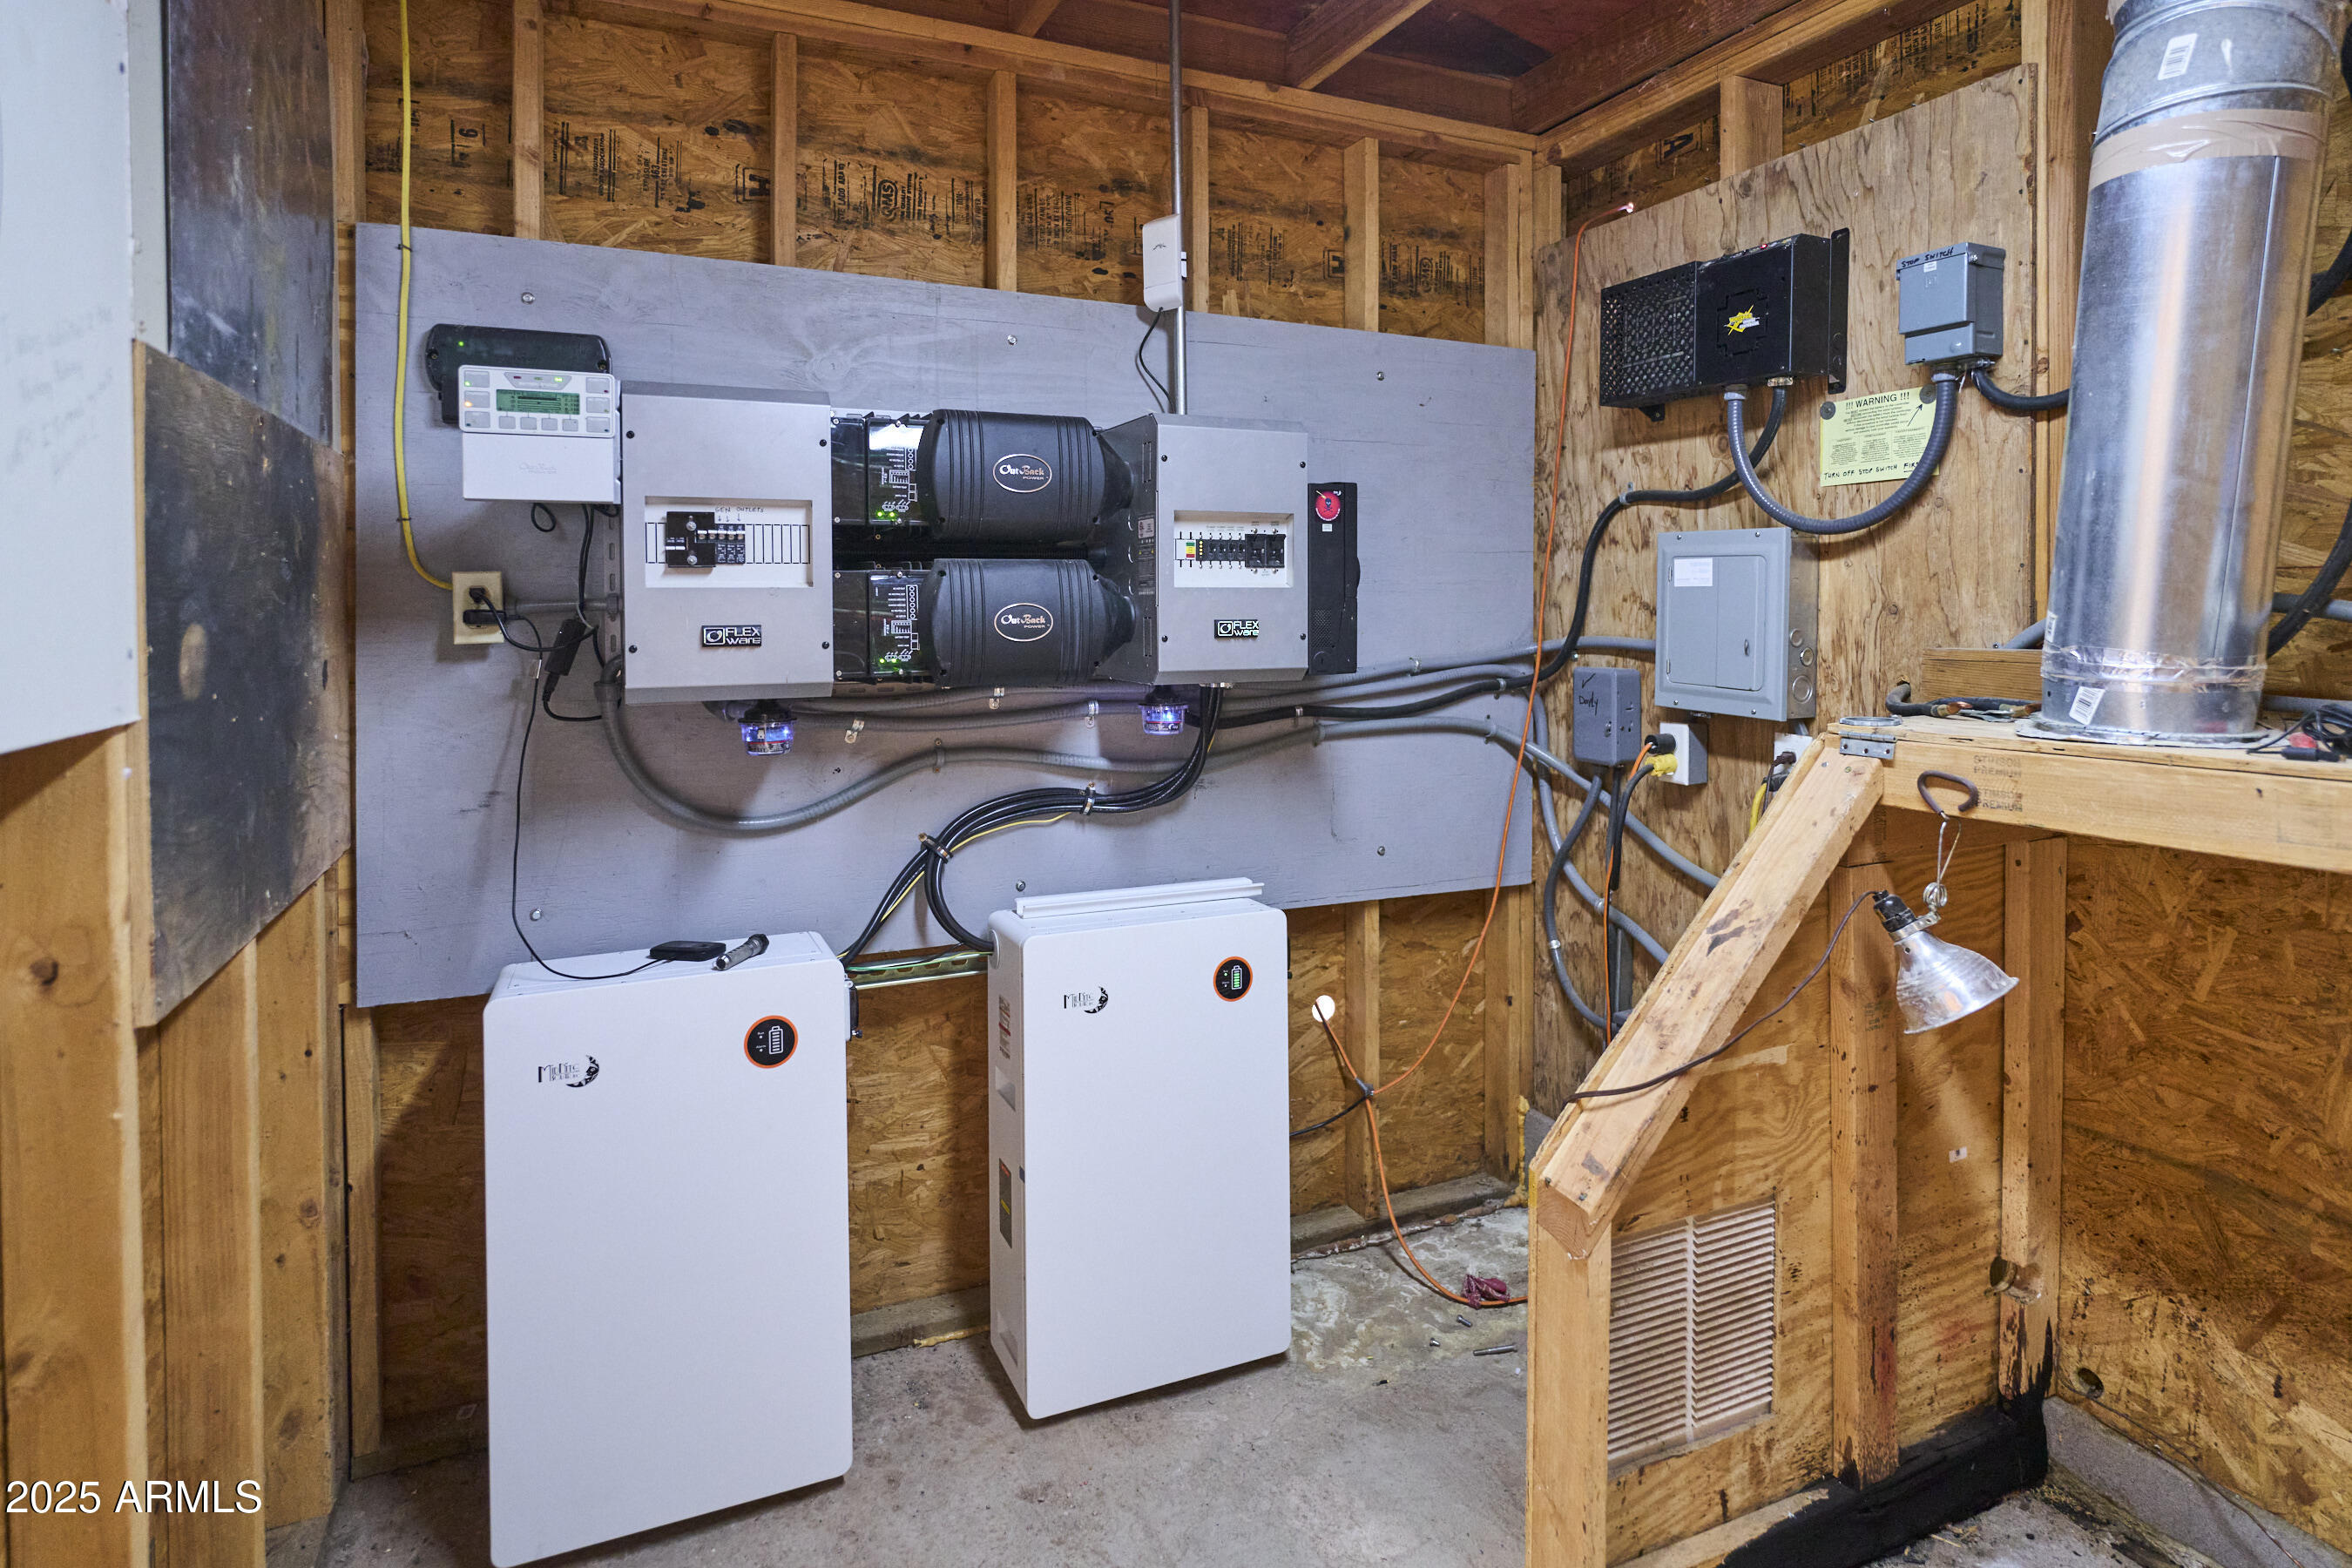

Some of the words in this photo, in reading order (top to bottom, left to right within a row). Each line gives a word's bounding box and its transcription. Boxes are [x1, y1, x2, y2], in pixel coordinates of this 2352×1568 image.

[1902, 258, 1920, 267] STOP
[1925, 247, 1953, 260] SWITCH
[1855, 394, 1897, 408] WARNING
[726, 627, 760, 637] FLEX
